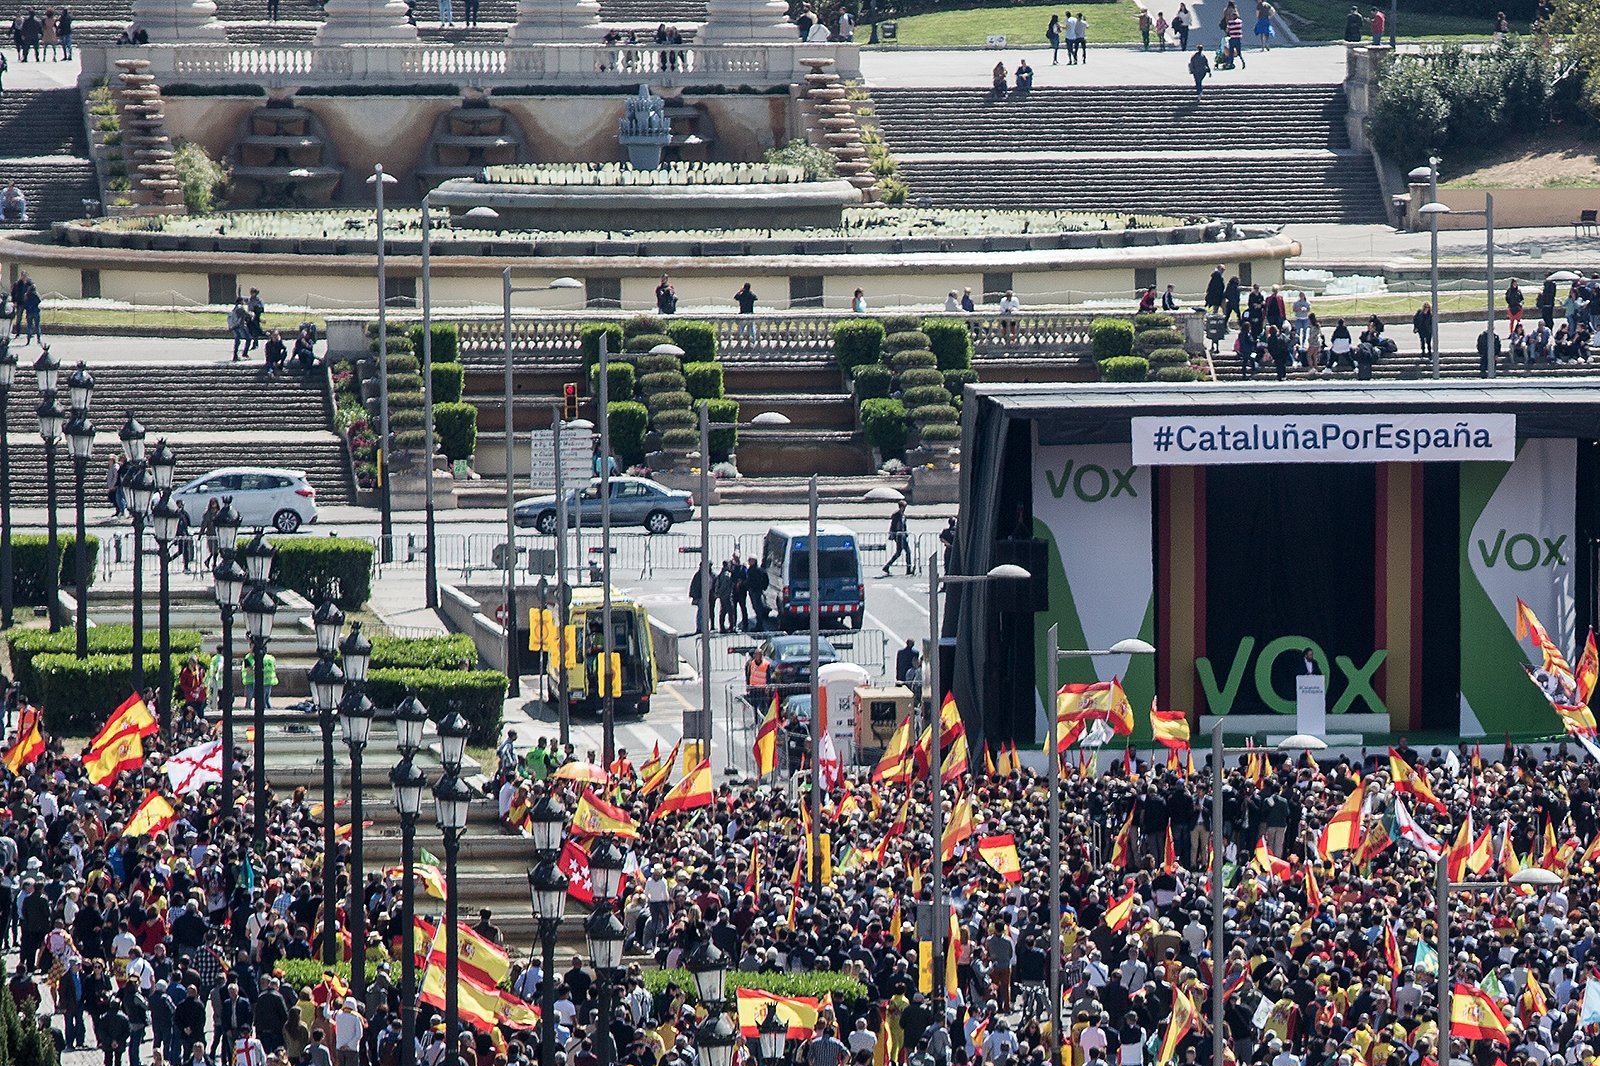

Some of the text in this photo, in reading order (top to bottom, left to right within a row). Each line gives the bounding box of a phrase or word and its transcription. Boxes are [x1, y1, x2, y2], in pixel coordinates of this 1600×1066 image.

[1153, 422, 1493, 455] #CataluñaPorEspaña
[1045, 459, 1138, 502] VOX
[1477, 528, 1567, 571] VOX
[1195, 635, 1390, 715] VOX
